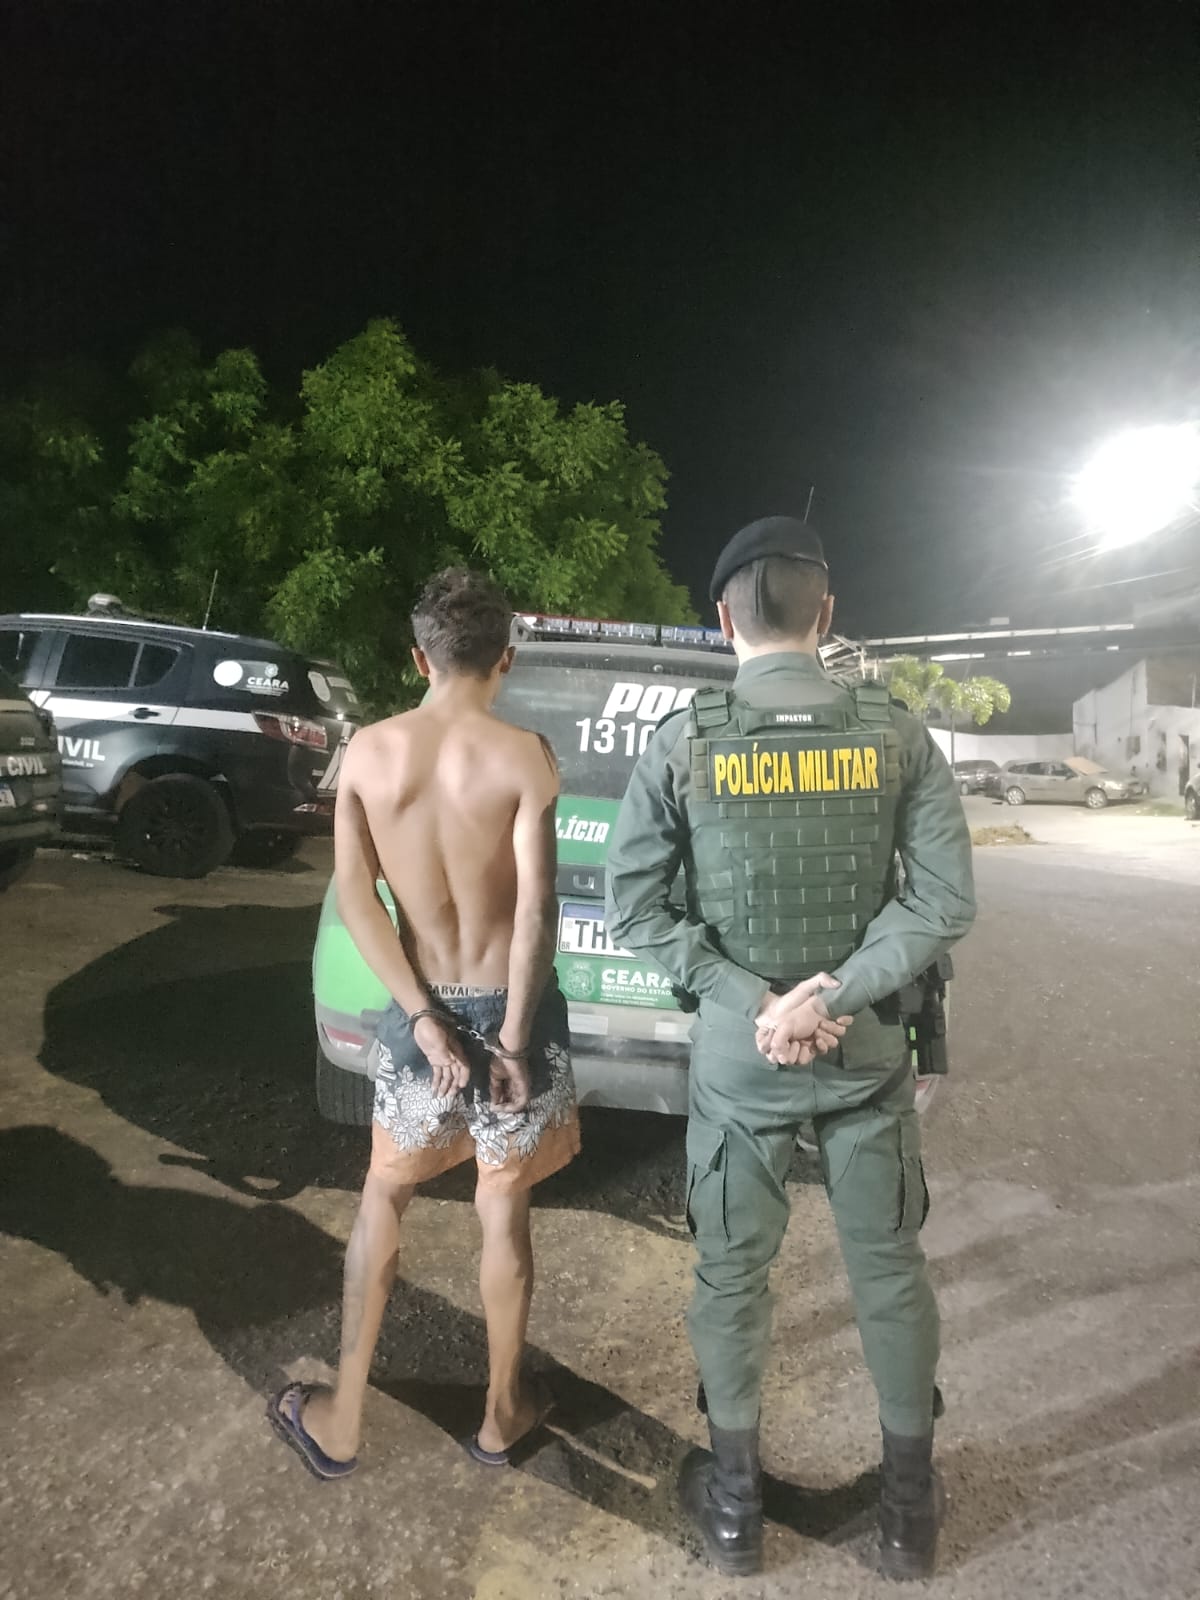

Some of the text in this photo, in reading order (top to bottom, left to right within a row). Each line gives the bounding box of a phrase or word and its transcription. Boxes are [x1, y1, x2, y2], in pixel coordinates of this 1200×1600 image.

[7, 756, 47, 776] CIVIL
[714, 742, 879, 796] POLÍCIA MILITAR
[574, 920, 620, 951] TH
[602, 984, 635, 993] GOVERNO
[649, 988, 672, 996] ESTAD
